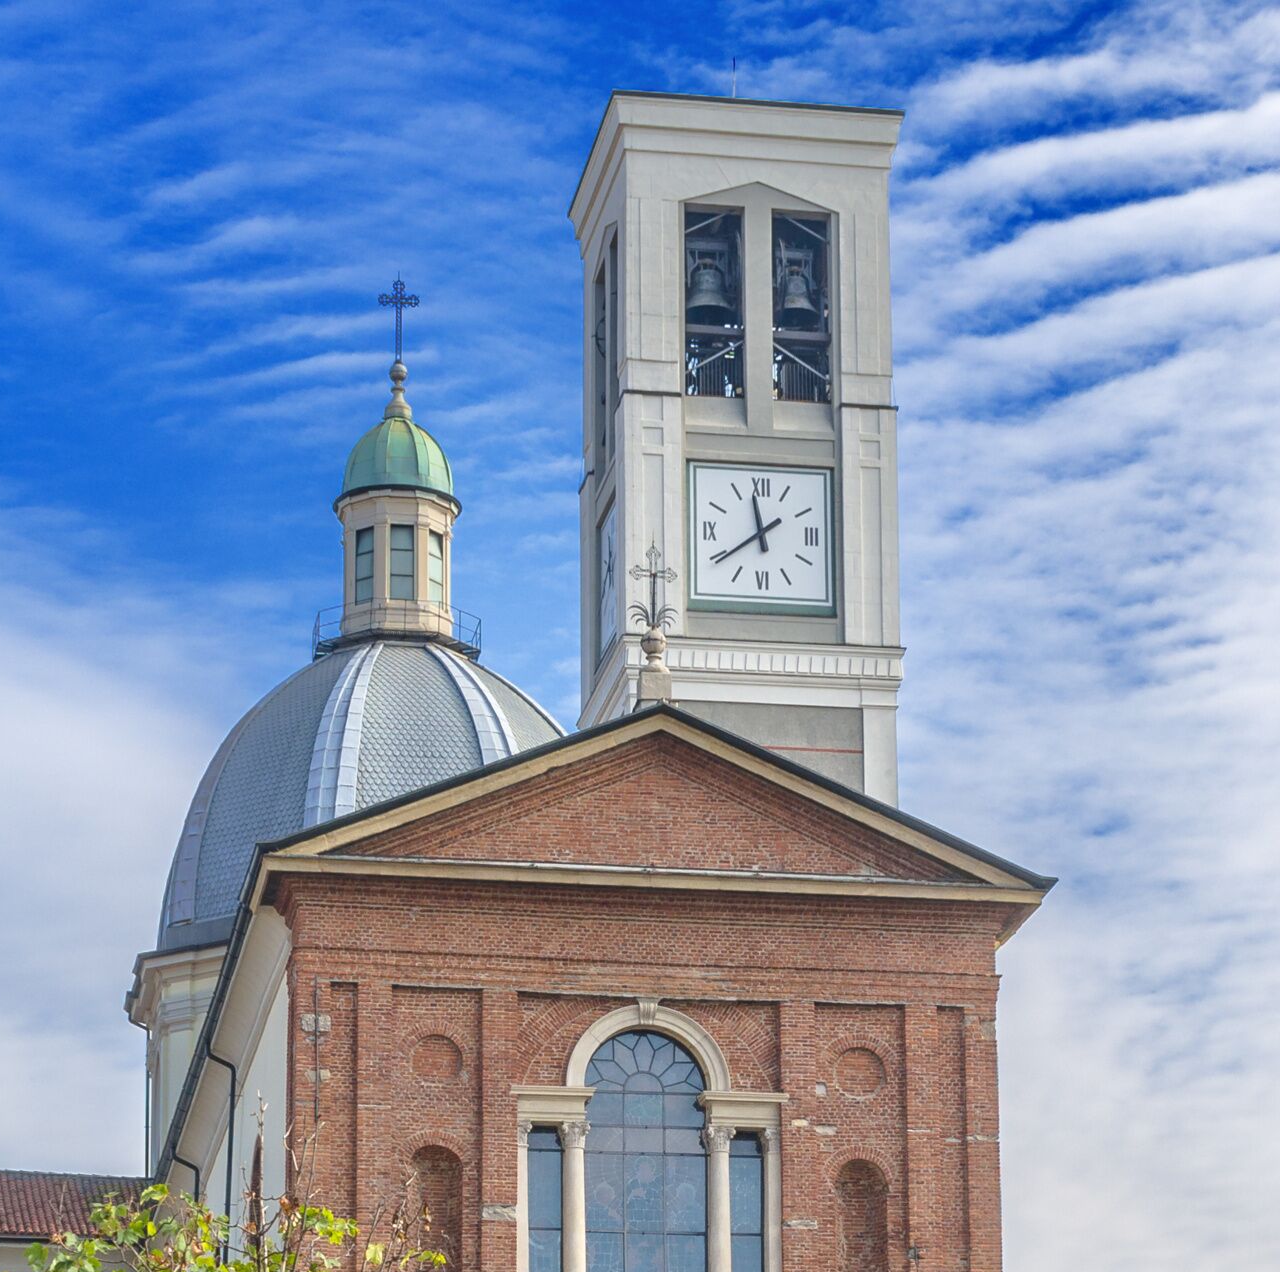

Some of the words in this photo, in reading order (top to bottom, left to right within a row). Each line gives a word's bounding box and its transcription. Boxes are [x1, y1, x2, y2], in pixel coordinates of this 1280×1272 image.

[751, 477, 770, 497] XII
[703, 521, 717, 541] IX
[804, 527, 819, 546] III
[755, 571, 769, 590] VI
